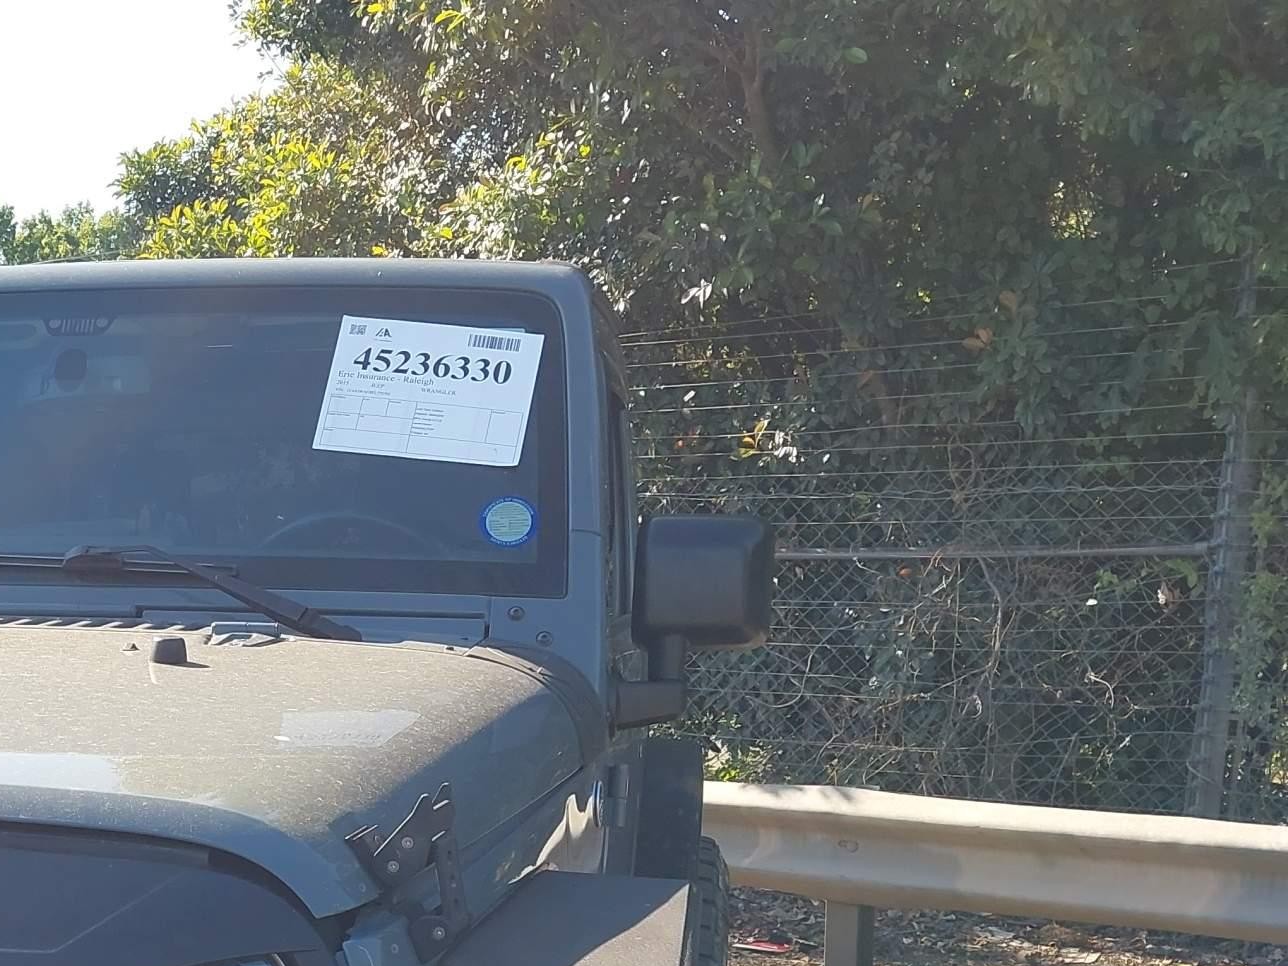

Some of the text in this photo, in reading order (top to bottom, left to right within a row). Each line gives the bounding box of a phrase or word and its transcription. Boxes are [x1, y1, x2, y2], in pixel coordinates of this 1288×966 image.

[338, 370, 355, 379] Erie
[357, 371, 395, 382] Insurance
[403, 375, 434, 386] Raleigh
[353, 347, 512, 385] 45236330
